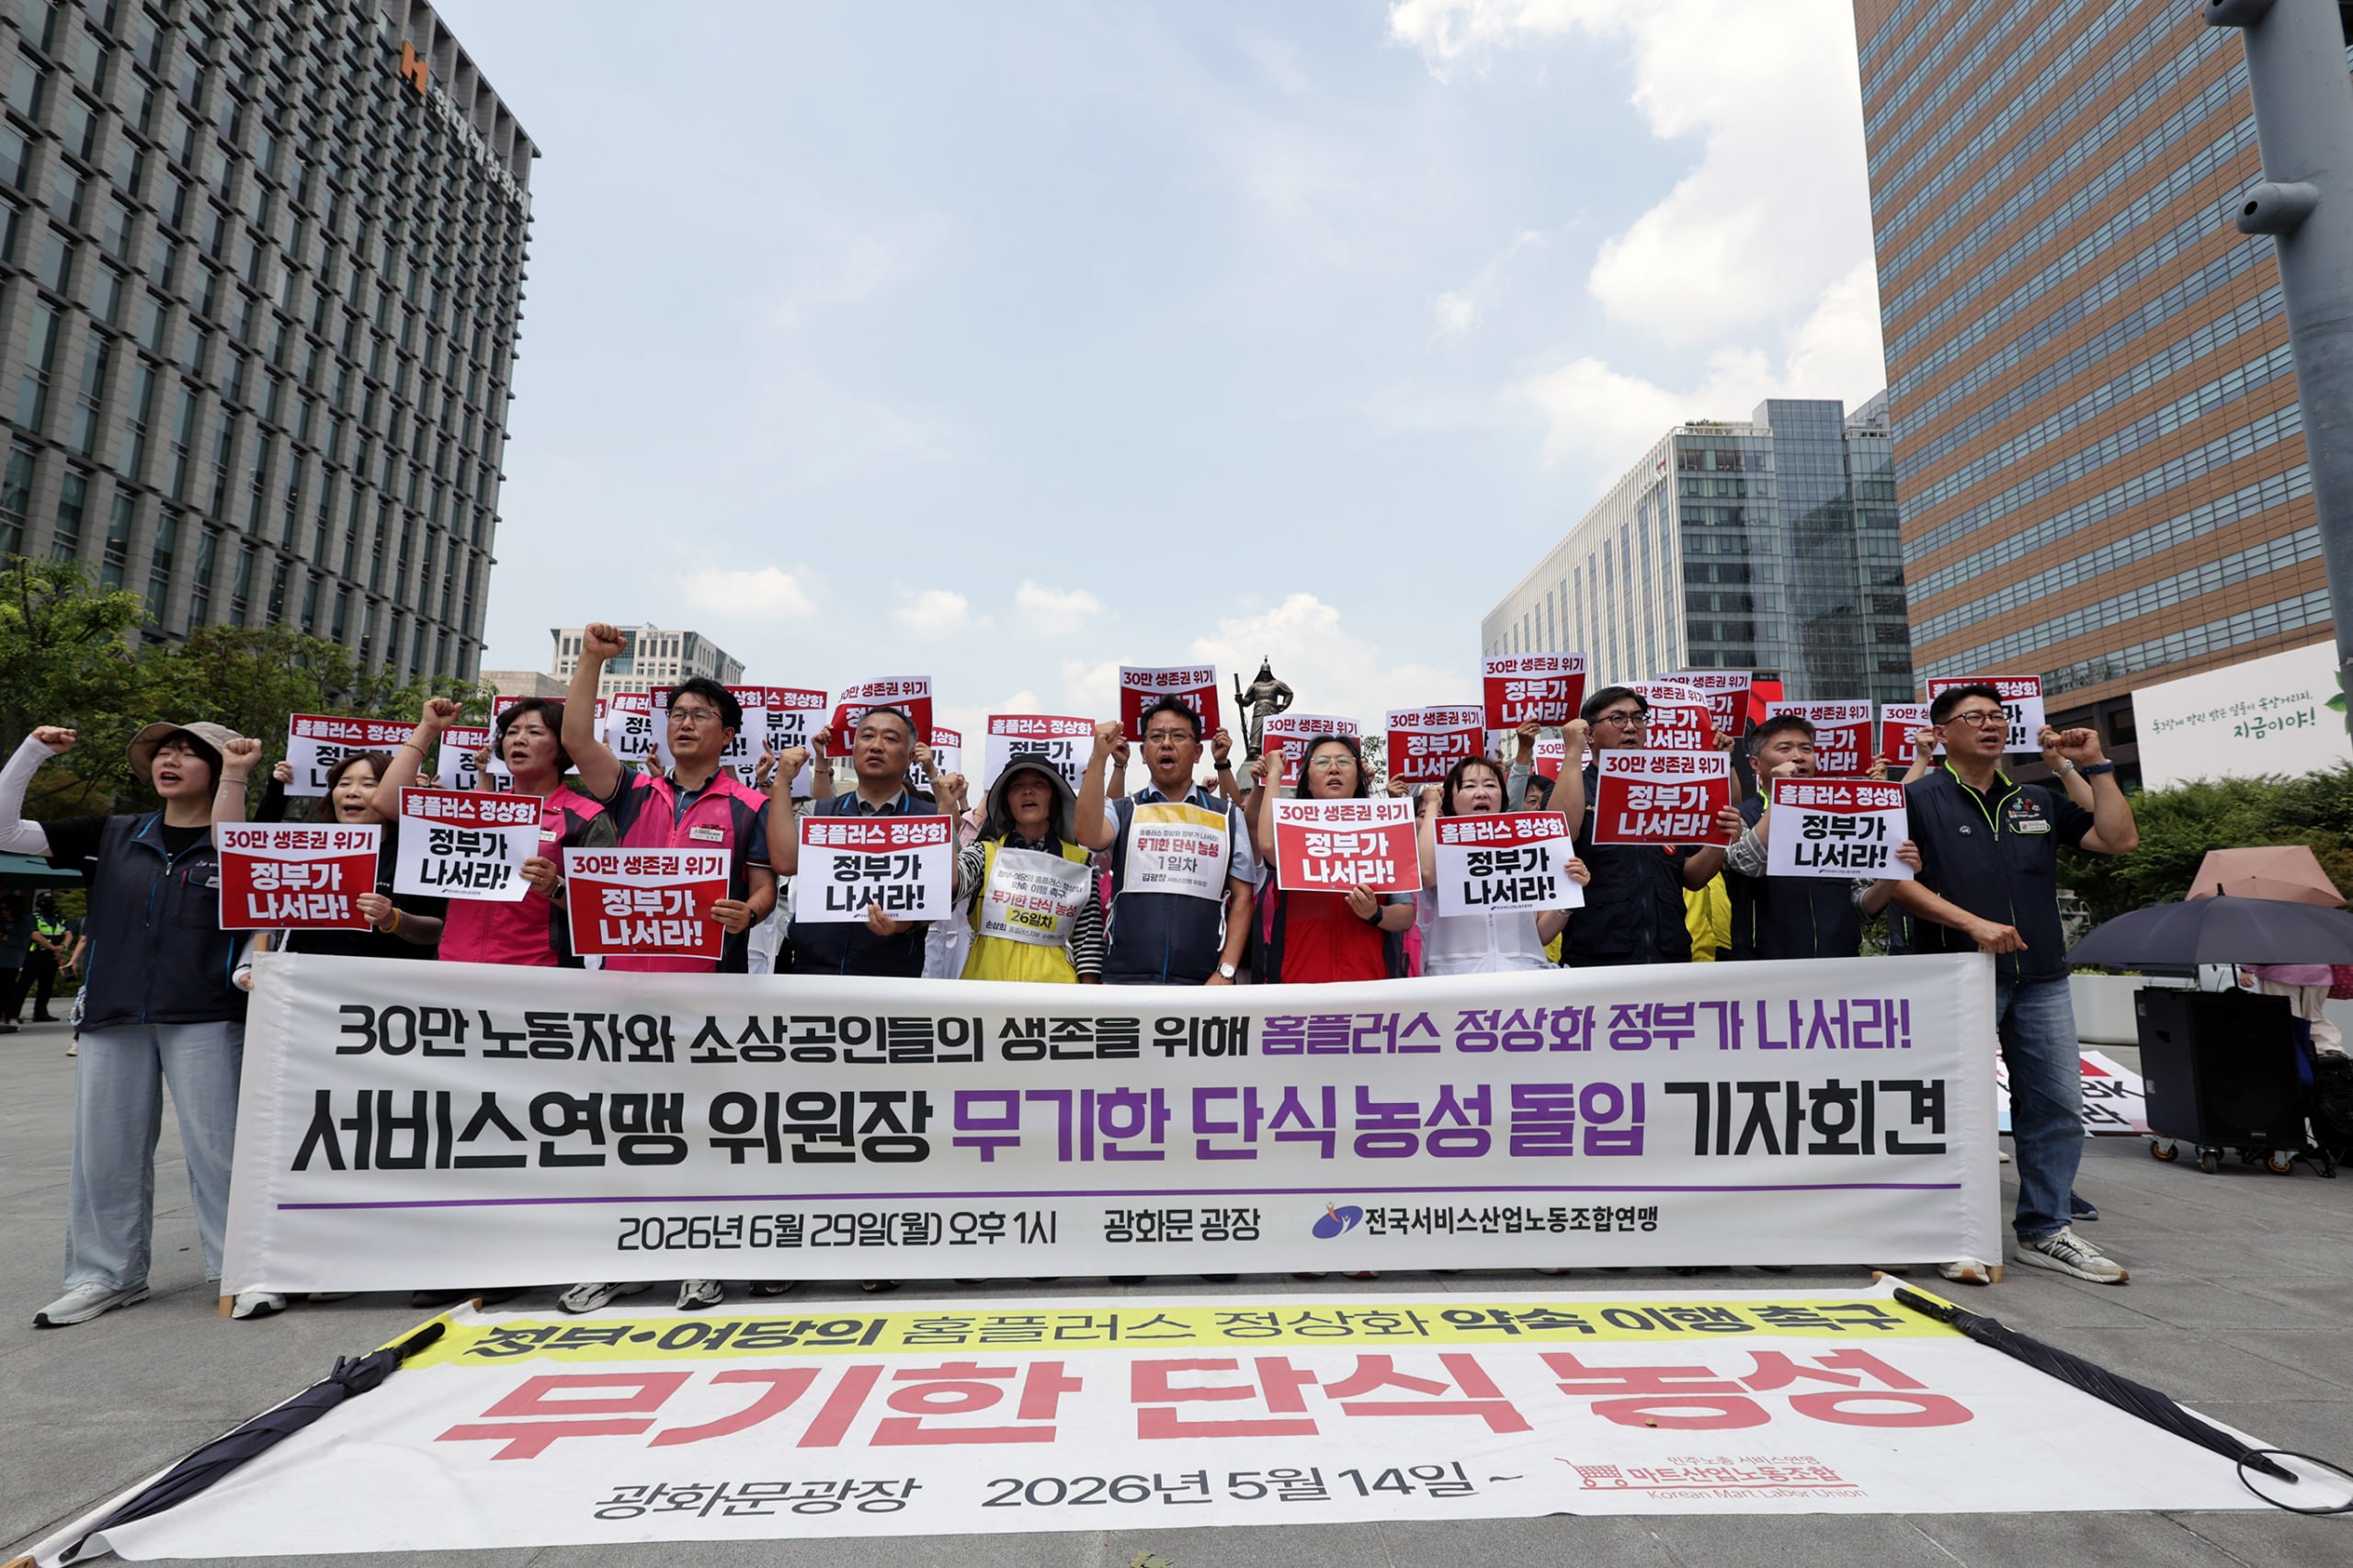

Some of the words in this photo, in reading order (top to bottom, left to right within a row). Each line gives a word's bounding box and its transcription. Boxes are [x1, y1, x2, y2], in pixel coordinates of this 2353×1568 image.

[1486, 660, 1518, 675] 30만
[1520, 657, 1560, 673] 생존권
[1562, 656, 1585, 672] 위기
[861, 682, 899, 698] 생존권
[902, 681, 927, 695] 위기
[1123, 672, 1153, 687] 30만
[1155, 671, 1191, 687] 생존권
[1193, 669, 1213, 684] 위기
[1693, 675, 1726, 688] 생존권
[1729, 676, 1748, 687] 위기
[1996, 681, 2038, 698] 정상화
[783, 692, 824, 709] 정상화
[1505, 679, 1568, 702] 정부가
[1651, 687, 1686, 700] 생존권
[1688, 689, 1707, 705] 위기
[614, 696, 650, 711] 홈플러
[1501, 701, 1569, 723] 나서라!
[1810, 706, 1847, 721] 생존권
[1849, 705, 1869, 719] 위기
[1887, 709, 1916, 720] 30만
[296, 719, 363, 740] 홈플러스
[767, 712, 805, 732] 부가
[992, 719, 1047, 734] 홈플러스
[1050, 719, 1092, 736] 정상화
[1267, 719, 1295, 732] 30만
[1299, 719, 1334, 733] 생존권
[1336, 721, 1358, 735] 위기
[1390, 713, 1420, 727] 30만
[1423, 711, 1460, 726] 생존권
[1461, 711, 1480, 725] 위기
[2234, 707, 2315, 739] 지금이야!
[1407, 733, 1471, 756] 정부가
[1813, 728, 1857, 751] 부가
[1606, 756, 1647, 773] 30만
[1650, 756, 1696, 774] 생존권
[1699, 757, 1724, 774] 위기
[1627, 785, 1710, 812] 정부가
[1779, 784, 1851, 805] 홈플러스
[1856, 787, 1903, 808] 정상화
[406, 794, 476, 820] 홈플러스
[479, 800, 536, 824] 정상화
[1279, 805, 1320, 822] 30만
[1324, 804, 1372, 822] 생존권
[1376, 803, 1409, 821] 위기
[807, 823, 886, 845] 홈플러스
[890, 823, 947, 844] 정상화
[1441, 820, 1513, 844] 홈플러스
[1515, 818, 1565, 838] 정상화
[1618, 812, 1711, 836] 나서라!
[1802, 814, 1887, 841] 정부가
[224, 831, 268, 848] 30만
[273, 831, 328, 849] 생존권
[334, 832, 373, 850] 위기
[429, 828, 507, 859] 정부가
[1138, 837, 1170, 852] 무기한
[1173, 838, 1196, 854] 단식
[1198, 841, 1220, 858] 농성
[1305, 833, 1390, 858] 정부가
[573, 856, 619, 874] 30만
[624, 856, 679, 875] 생존권
[685, 857, 723, 876] 위기
[1467, 846, 1550, 877] 정부가
[1794, 843, 1889, 869] 나서라!
[250, 862, 343, 892] 정부가
[420, 858, 511, 890] 나서라!
[833, 854, 921, 882] 정부가
[1302, 858, 1396, 885] 나서라!
[825, 884, 925, 911] 나서라!
[1463, 876, 1557, 905] 나서라!
[246, 892, 350, 920] 나서라!
[601, 889, 696, 917] 정부가
[992, 890, 1028, 908] 무기한
[1029, 896, 1053, 913] 단식
[1055, 902, 1078, 917] 농성
[1011, 909, 1052, 929] 26일차
[598, 919, 704, 947] 나서라!
[335, 1005, 469, 1057] 30만
[478, 1010, 676, 1063] 노동자와
[690, 1015, 983, 1063] 소상공인들의
[998, 1016, 1141, 1062] 생존을
[1153, 1016, 1250, 1058] 위해
[1261, 1011, 1441, 1056] 홈플러스
[1454, 1006, 1596, 1053] 정상화
[1607, 1000, 1745, 1051] 정부가
[1756, 998, 1912, 1050] 나서라!
[290, 1089, 688, 1171] 서비스연맹
[708, 1090, 934, 1165] 위원장
[952, 1086, 1171, 1163] 무기한
[1192, 1085, 1336, 1160] 단식
[1353, 1084, 1493, 1159] 농성
[1508, 1082, 1645, 1158] 돌입
[1664, 1078, 1947, 1156] 기자회견
[618, 1214, 744, 1251] 2026년
[749, 1213, 805, 1249] 6월
[810, 1211, 942, 1247] 29일(월)
[949, 1210, 1006, 1246] 오후
[1012, 1210, 1057, 1244] 1시
[1103, 1208, 1194, 1244] 광화문
[1199, 1207, 1261, 1243] 광장
[1364, 1205, 1659, 1235] 전국서비스산업노동조합연맹
[903, 1313, 1197, 1346] 홈플러스
[1214, 1309, 1429, 1338] 정상화
[1439, 1307, 1590, 1335] 약속
[1598, 1306, 1756, 1335] 이행
[1747, 1303, 1909, 1335] 촉구
[432, 1361, 1085, 1461] 무기한
[1131, 1353, 1535, 1440] 단식
[1538, 1347, 1974, 1430] 농성
[1667, 1455, 1735, 1465] 민주노총
[1738, 1455, 1821, 1465] 서비스연맹
[1627, 1465, 1843, 1483] 마트산업노동조합
[594, 1477, 923, 1521] 광화문광장
[981, 1470, 1212, 1507] 2026년
[1228, 1466, 1331, 1503] 5월
[1337, 1460, 1480, 1498] 14일
[1646, 1490, 1712, 1500] Korean
[1713, 1489, 1756, 1499] Mart
[1756, 1488, 1811, 1498] Labor
[1812, 1488, 1869, 1498] Union
